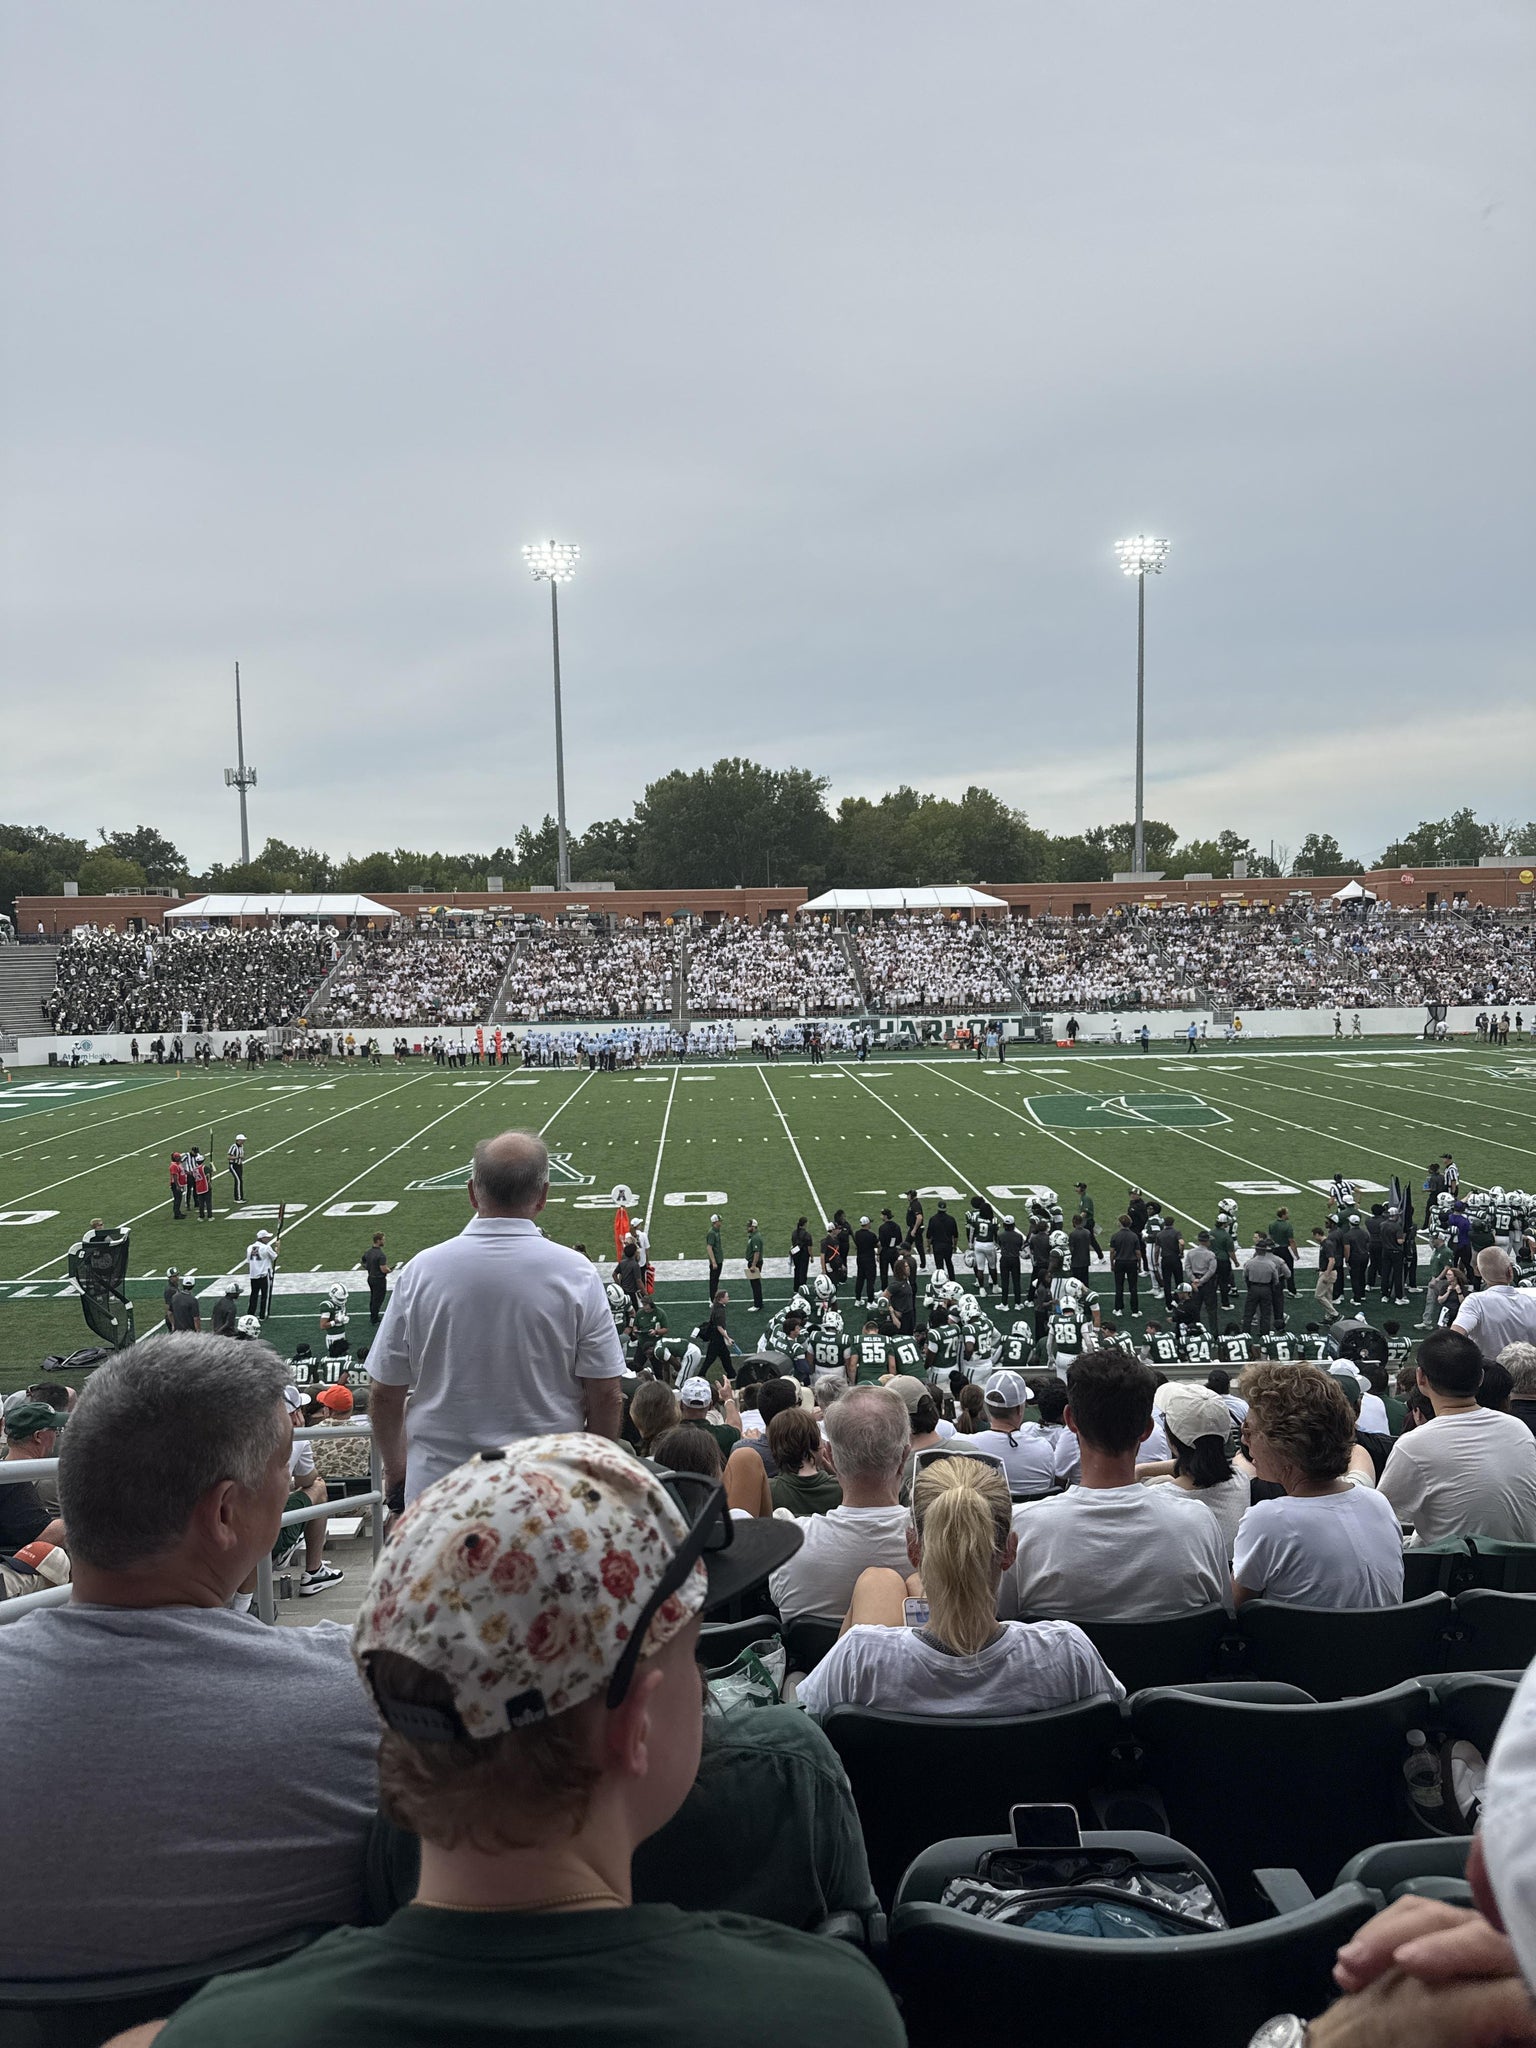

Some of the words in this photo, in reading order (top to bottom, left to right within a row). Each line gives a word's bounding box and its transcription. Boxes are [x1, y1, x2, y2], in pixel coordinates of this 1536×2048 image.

[979, 1223, 988, 1237] 9
[1495, 1214, 1511, 1229] 19
[816, 1343, 839, 1365] 68
[861, 1342, 886, 1363] 55
[898, 1343, 919, 1364] 61
[1008, 1341, 1022, 1360] 3
[1157, 1339, 1178, 1359] 81
[1186, 1341, 1210, 1362] 24
[1227, 1340, 1249, 1361] 21
[1276, 1341, 1290, 1361] 6
[1314, 1341, 1325, 1360] 7
[327, 1362, 341, 1382] 11
